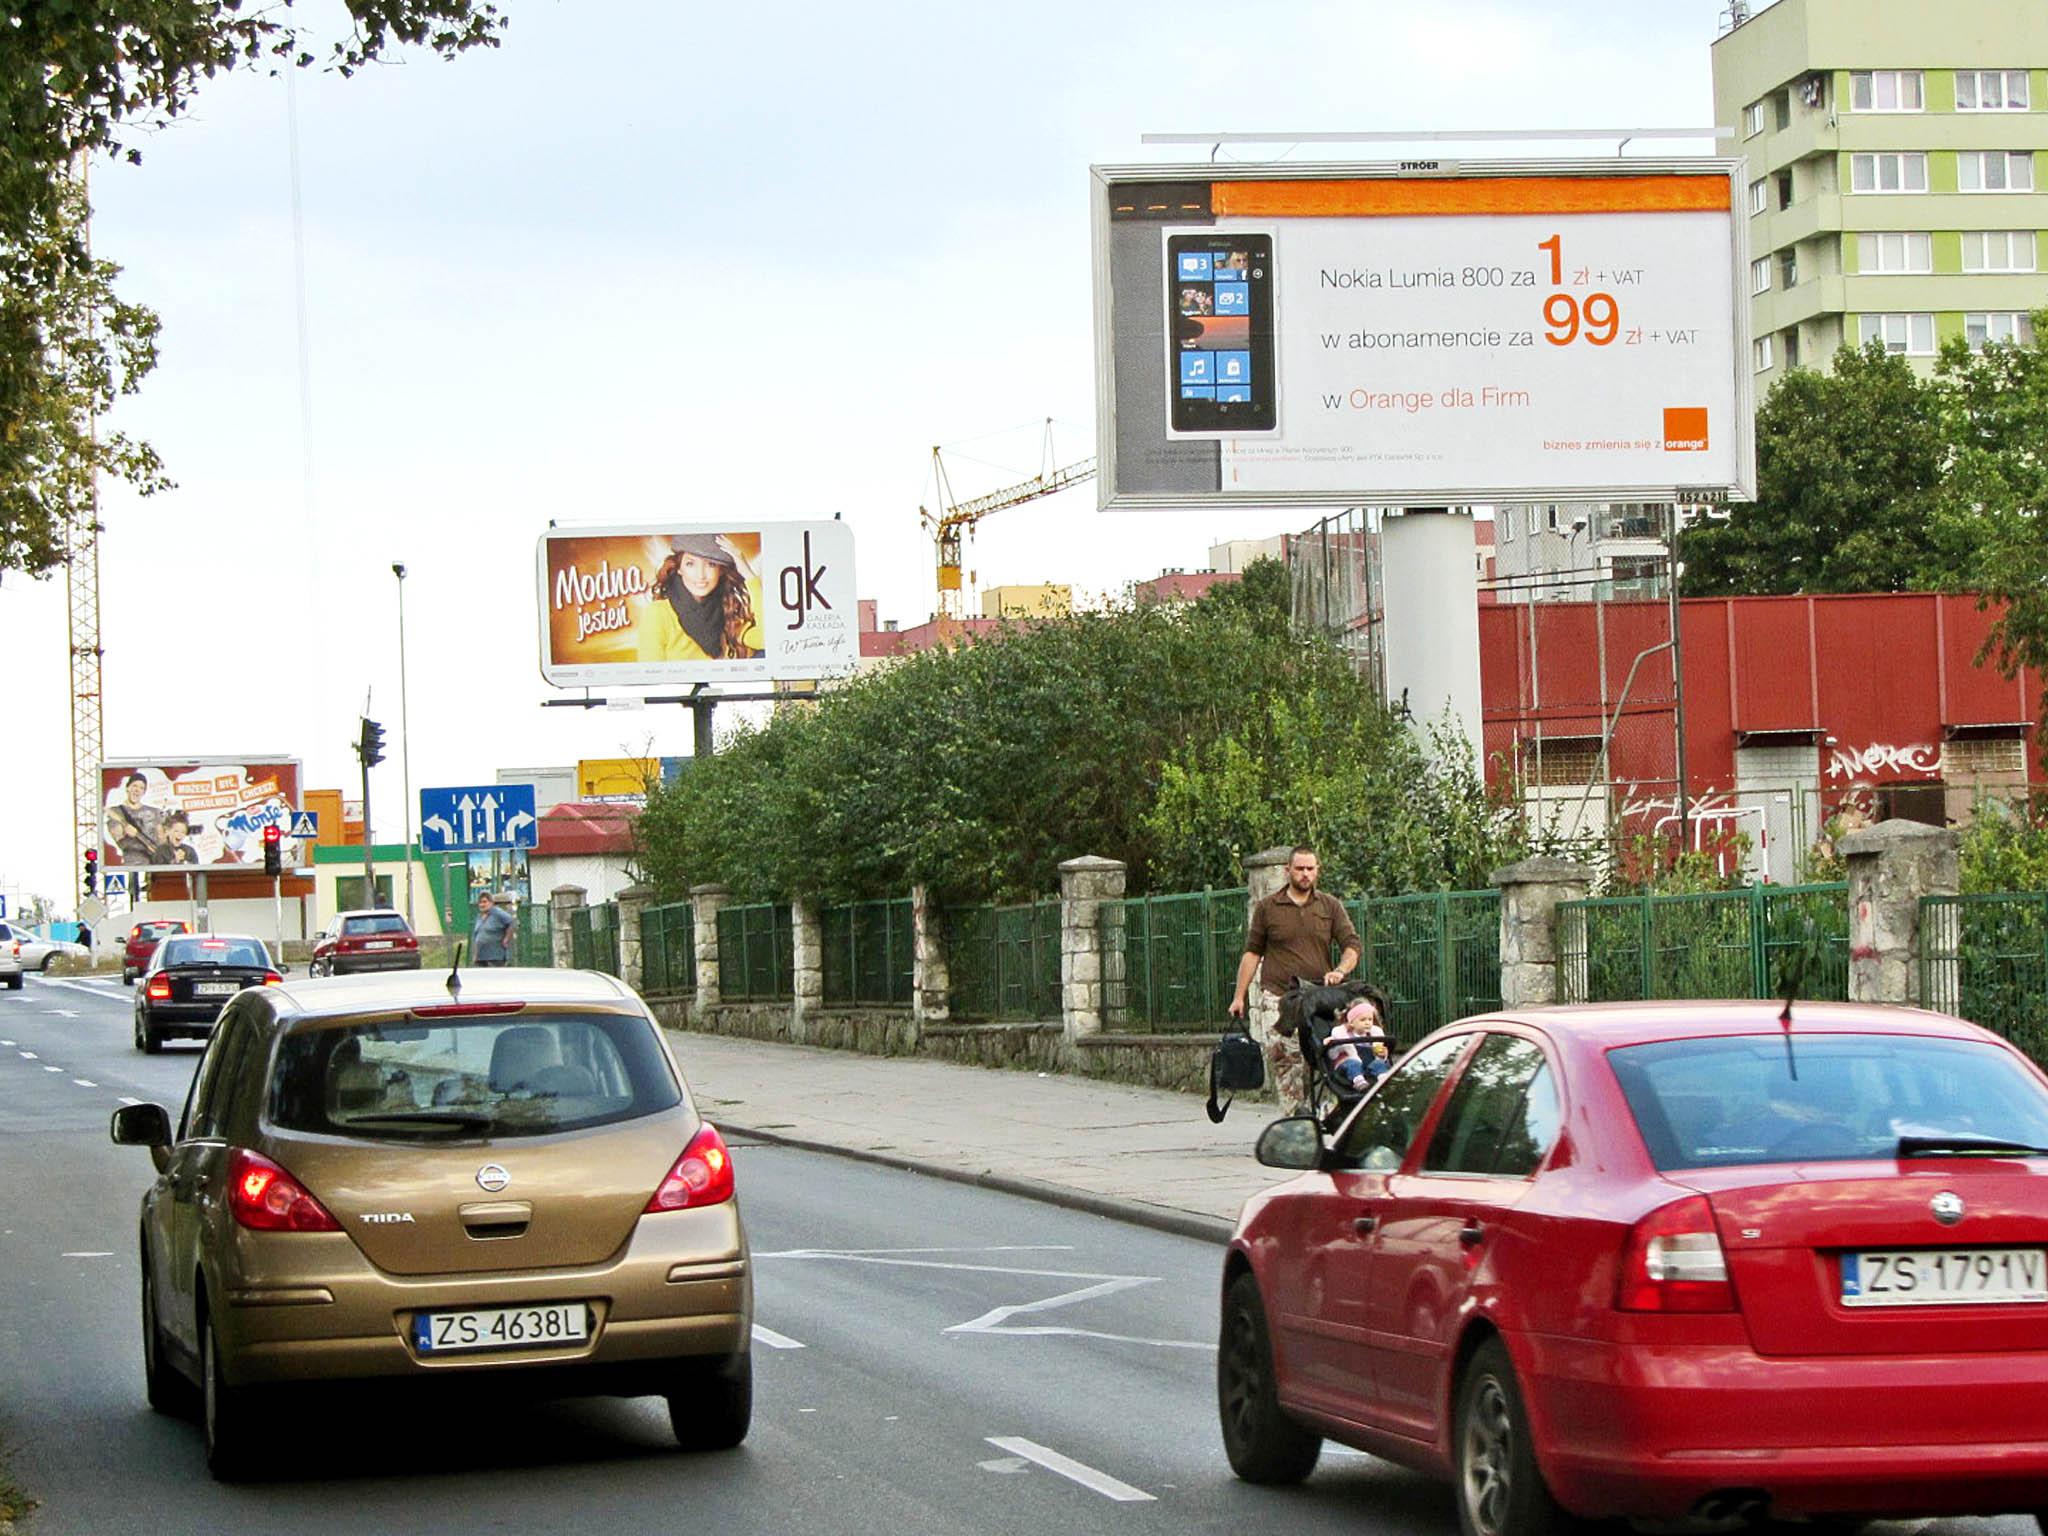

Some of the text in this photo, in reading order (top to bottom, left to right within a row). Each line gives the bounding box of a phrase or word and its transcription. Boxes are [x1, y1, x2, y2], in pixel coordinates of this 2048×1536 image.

[1320, 269, 1382, 288] Nokia
[1389, 268, 1455, 288] Lumia
[1461, 267, 1504, 287] 800
[1511, 270, 1536, 287] za
[1538, 234, 1562, 286] 1
[1573, 266, 1590, 286] zł
[1612, 270, 1645, 285] VAT
[1321, 334, 1340, 349] w
[1349, 328, 1501, 349] abonamencie
[1508, 331, 1534, 347] za
[1543, 292, 1619, 346] 99
[1625, 326, 1642, 345] zł
[1666, 329, 1699, 344] VAT
[1322, 386, 1530, 414] w Orange dla Firm
[1543, 440, 1582, 450] biznes
[1585, 440, 1632, 449] zmienia
[1665, 440, 1704, 450] orange
[556, 560, 647, 610] Modna
[780, 530, 832, 630] gk
[576, 600, 631, 642] jesień
[228, 804, 284, 833] Monte
[360, 1212, 416, 1223] TIIDA
[1866, 1253, 2039, 1292] ZS 1791V
[436, 1309, 581, 1345] ZS 4638L
